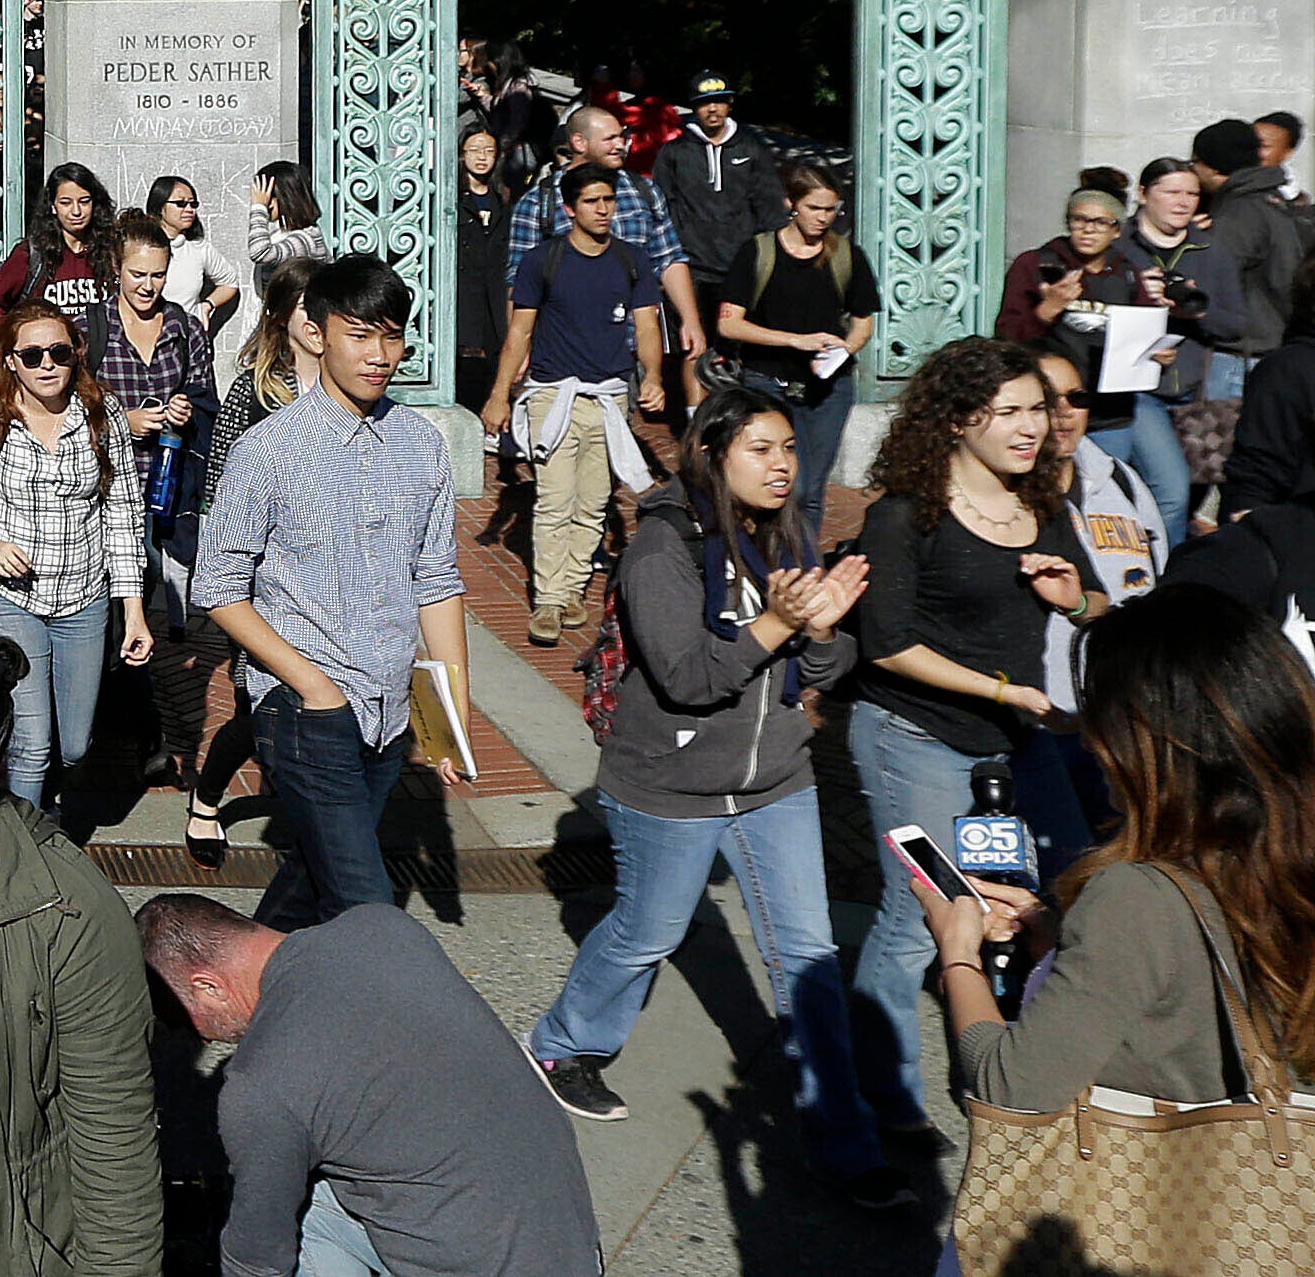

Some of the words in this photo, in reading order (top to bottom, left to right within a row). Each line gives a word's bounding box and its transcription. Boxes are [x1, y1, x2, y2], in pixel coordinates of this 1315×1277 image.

[120, 35, 136, 49] IN
[145, 35, 224, 49] MEMORY
[232, 34, 257, 49] OF
[103, 62, 178, 83] PEDER
[187, 61, 273, 83] SATHER
[136, 94, 172, 109] 1810
[198, 94, 239, 109] 1886
[113, 117, 195, 140] MONDAY
[199, 116, 274, 139] (TODAY)
[990, 822, 1019, 851] 5
[961, 851, 1020, 864] KPIX
